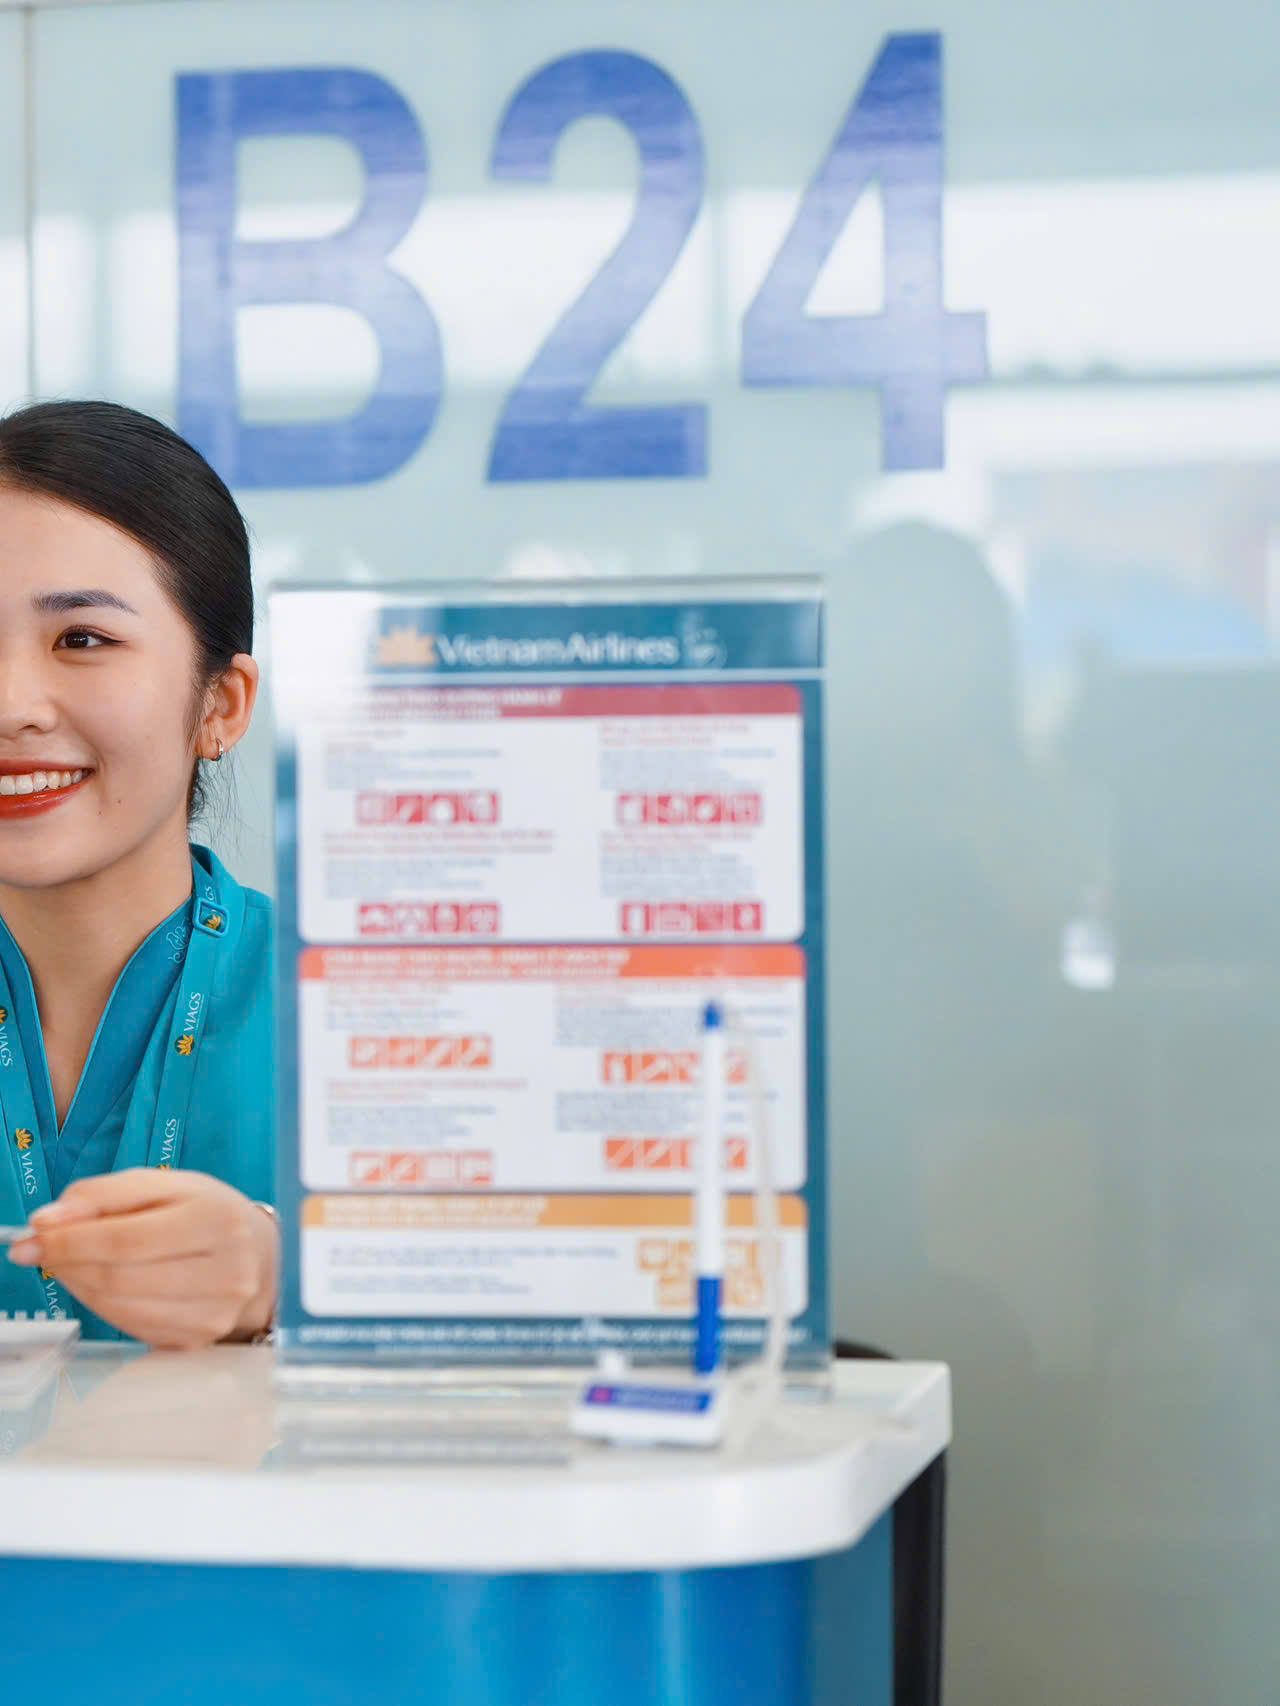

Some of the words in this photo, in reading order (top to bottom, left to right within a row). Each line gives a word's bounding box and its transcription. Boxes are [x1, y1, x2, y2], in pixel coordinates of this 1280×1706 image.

[174, 30, 989, 488] B24
[184, 991, 201, 1033] VIAGS
[160, 1118, 177, 1161] VIAGS
[21, 1151, 38, 1195] VIAGS
[46, 1280, 62, 1318] VIAG
